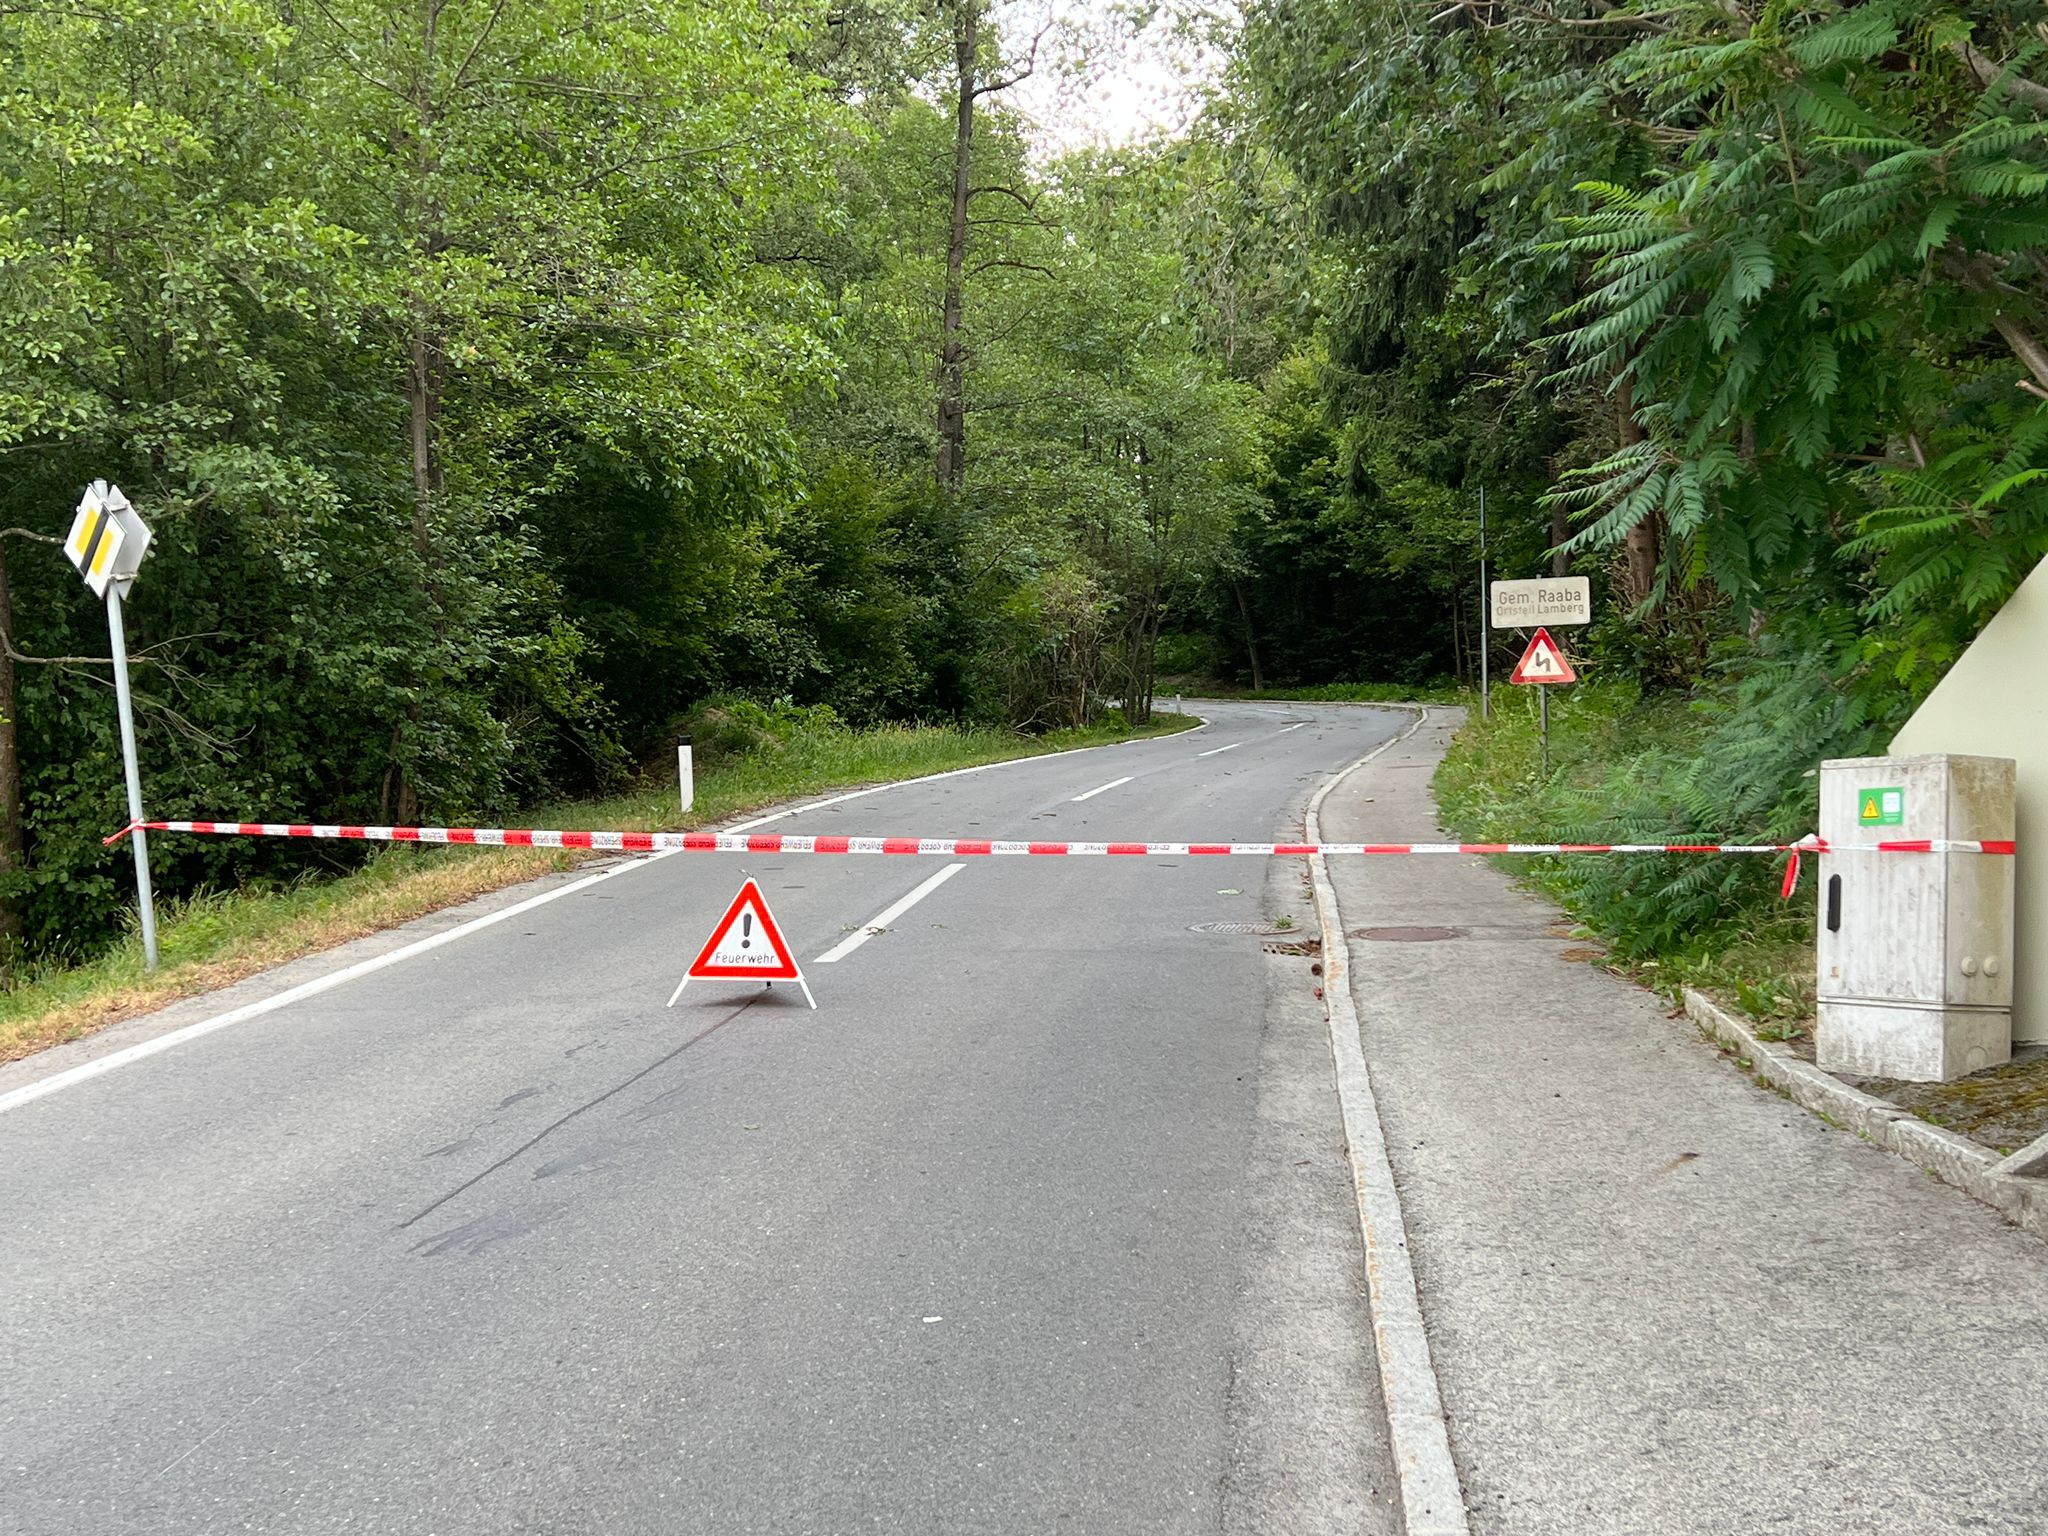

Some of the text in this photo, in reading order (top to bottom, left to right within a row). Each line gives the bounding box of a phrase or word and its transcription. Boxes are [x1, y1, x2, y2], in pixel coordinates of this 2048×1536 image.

[1499, 588, 1581, 604] Gem. Raaba
[1496, 603, 1584, 616] Ortsteil Lamberg
[715, 952, 775, 965] Feuerwehr
